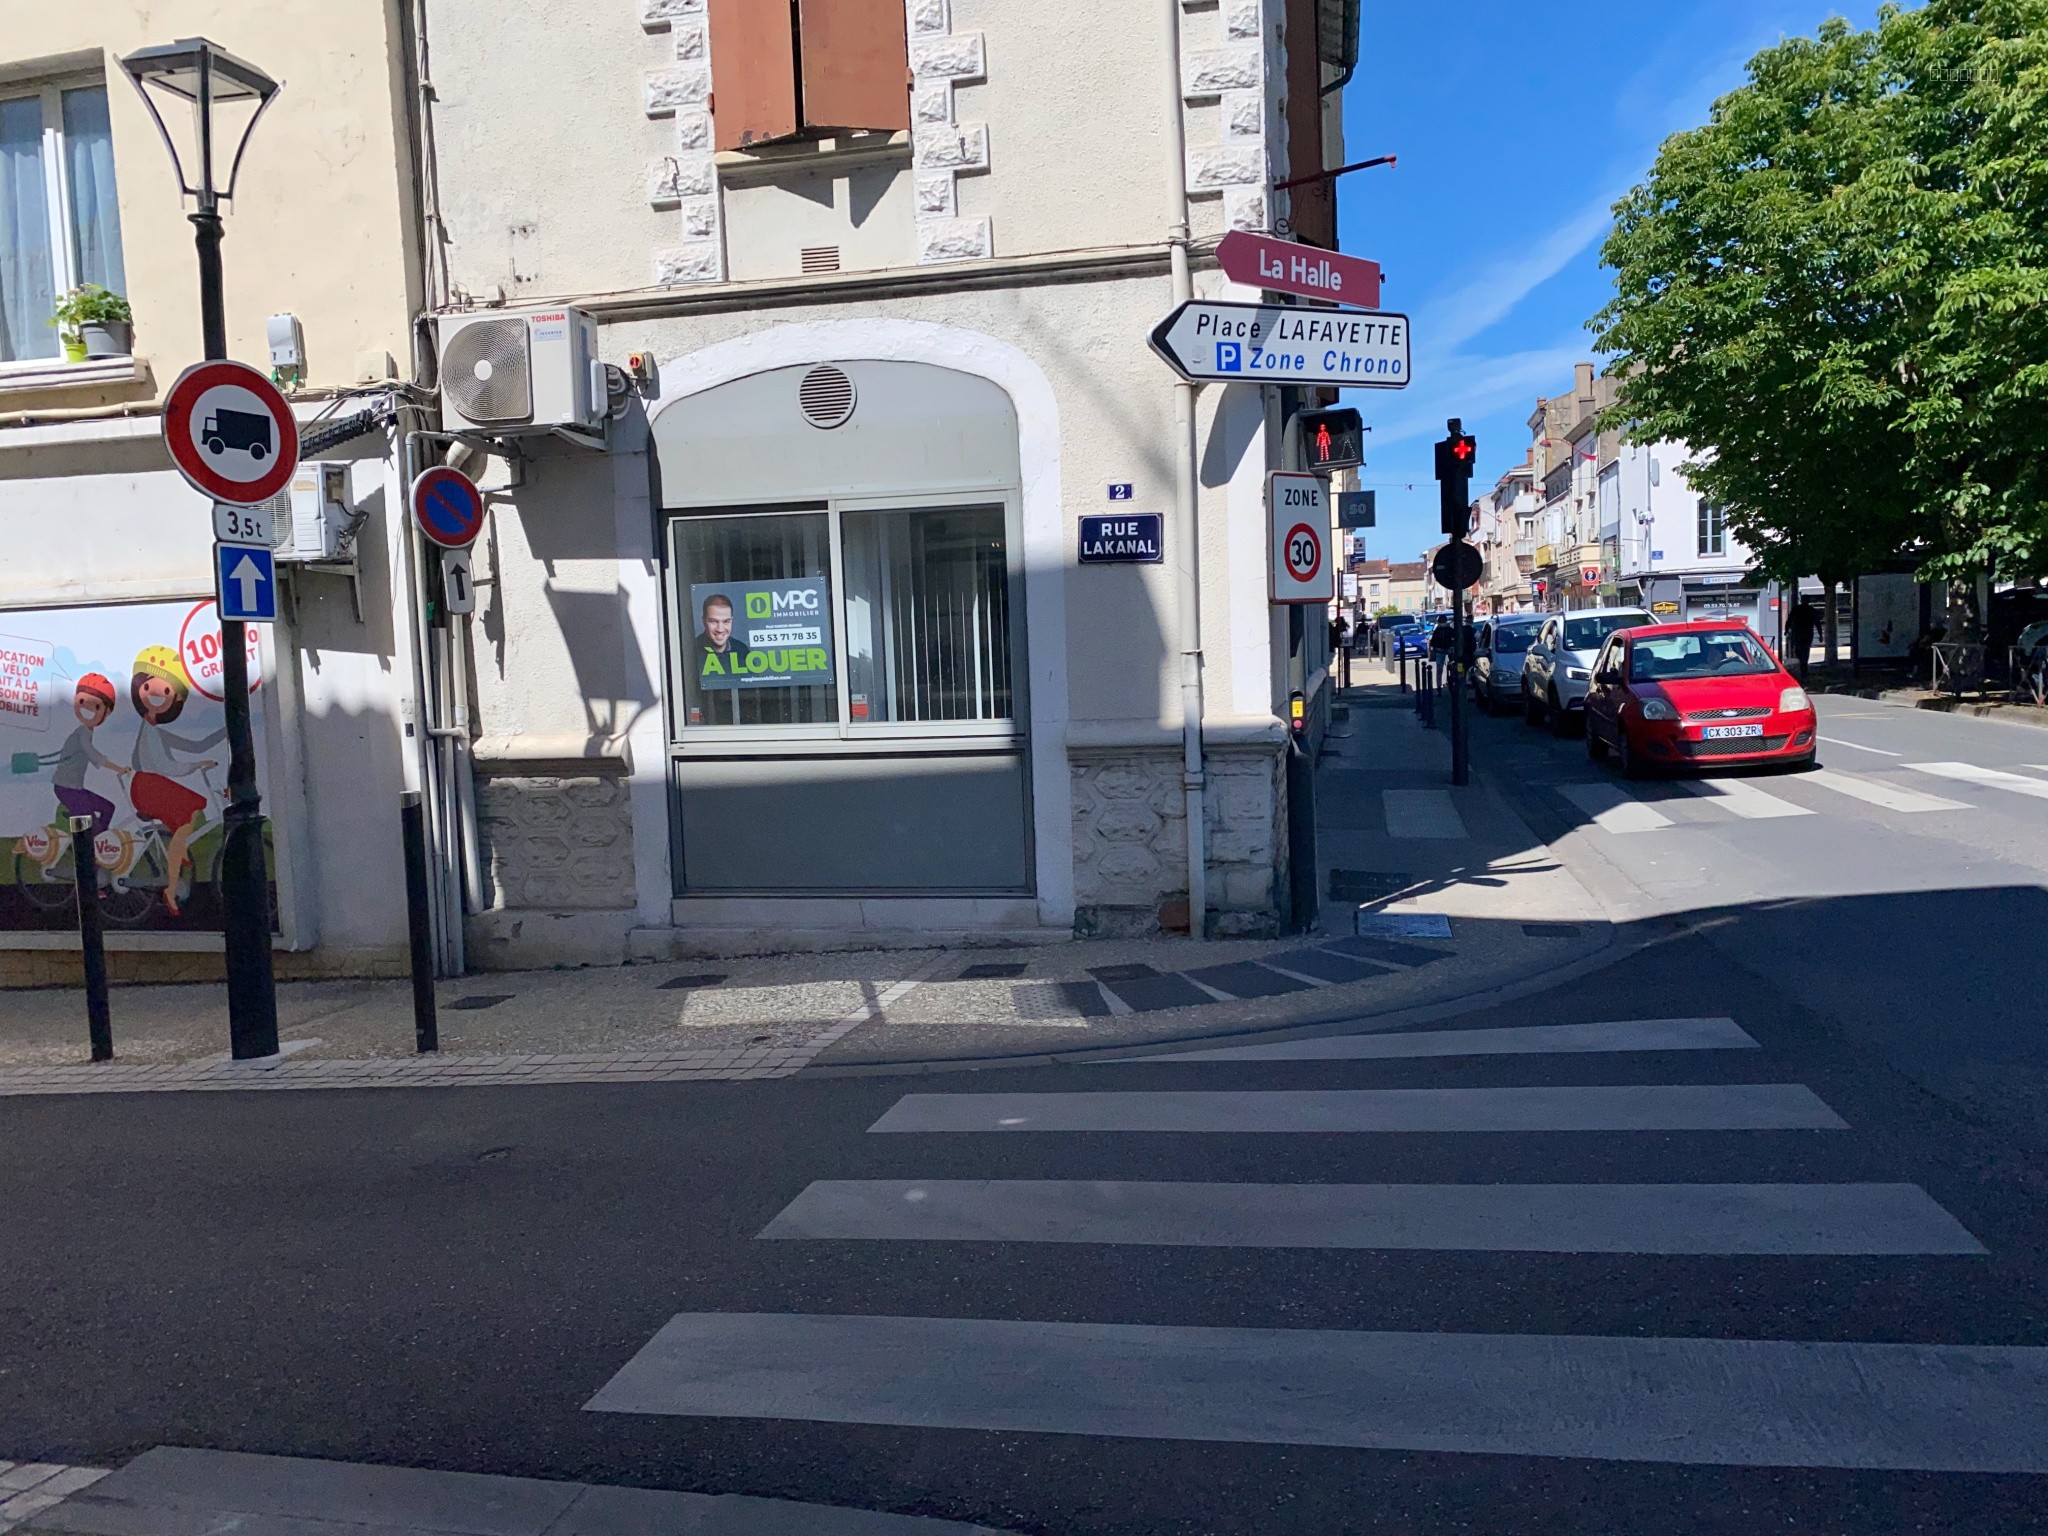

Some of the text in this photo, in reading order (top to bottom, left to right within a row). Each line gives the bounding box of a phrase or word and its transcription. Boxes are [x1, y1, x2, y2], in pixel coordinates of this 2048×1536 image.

[1260, 249, 1342, 291] La Halle
[531, 314, 566, 323] TOSHIBA
[1196, 314, 1402, 345] Place LAFAYETTE
[1250, 347, 1305, 370] Zone
[1323, 350, 1402, 375] Chrono
[1114, 485, 1125, 499] 2
[1285, 489, 1319, 507] ZONE
[1101, 522, 1139, 536] RUE
[1083, 540, 1157, 555] LAKANAL
[1291, 539, 1315, 567] 30
[772, 589, 819, 611] MPG
[773, 610, 819, 618] IMMOBILIER
[753, 631, 817, 643] 05 53 71 78 35
[701, 646, 828, 676] À LOUER
[3, 662, 30, 677] VÉLO
[25, 680, 38, 691] LA
[22, 692, 36, 703] DE
